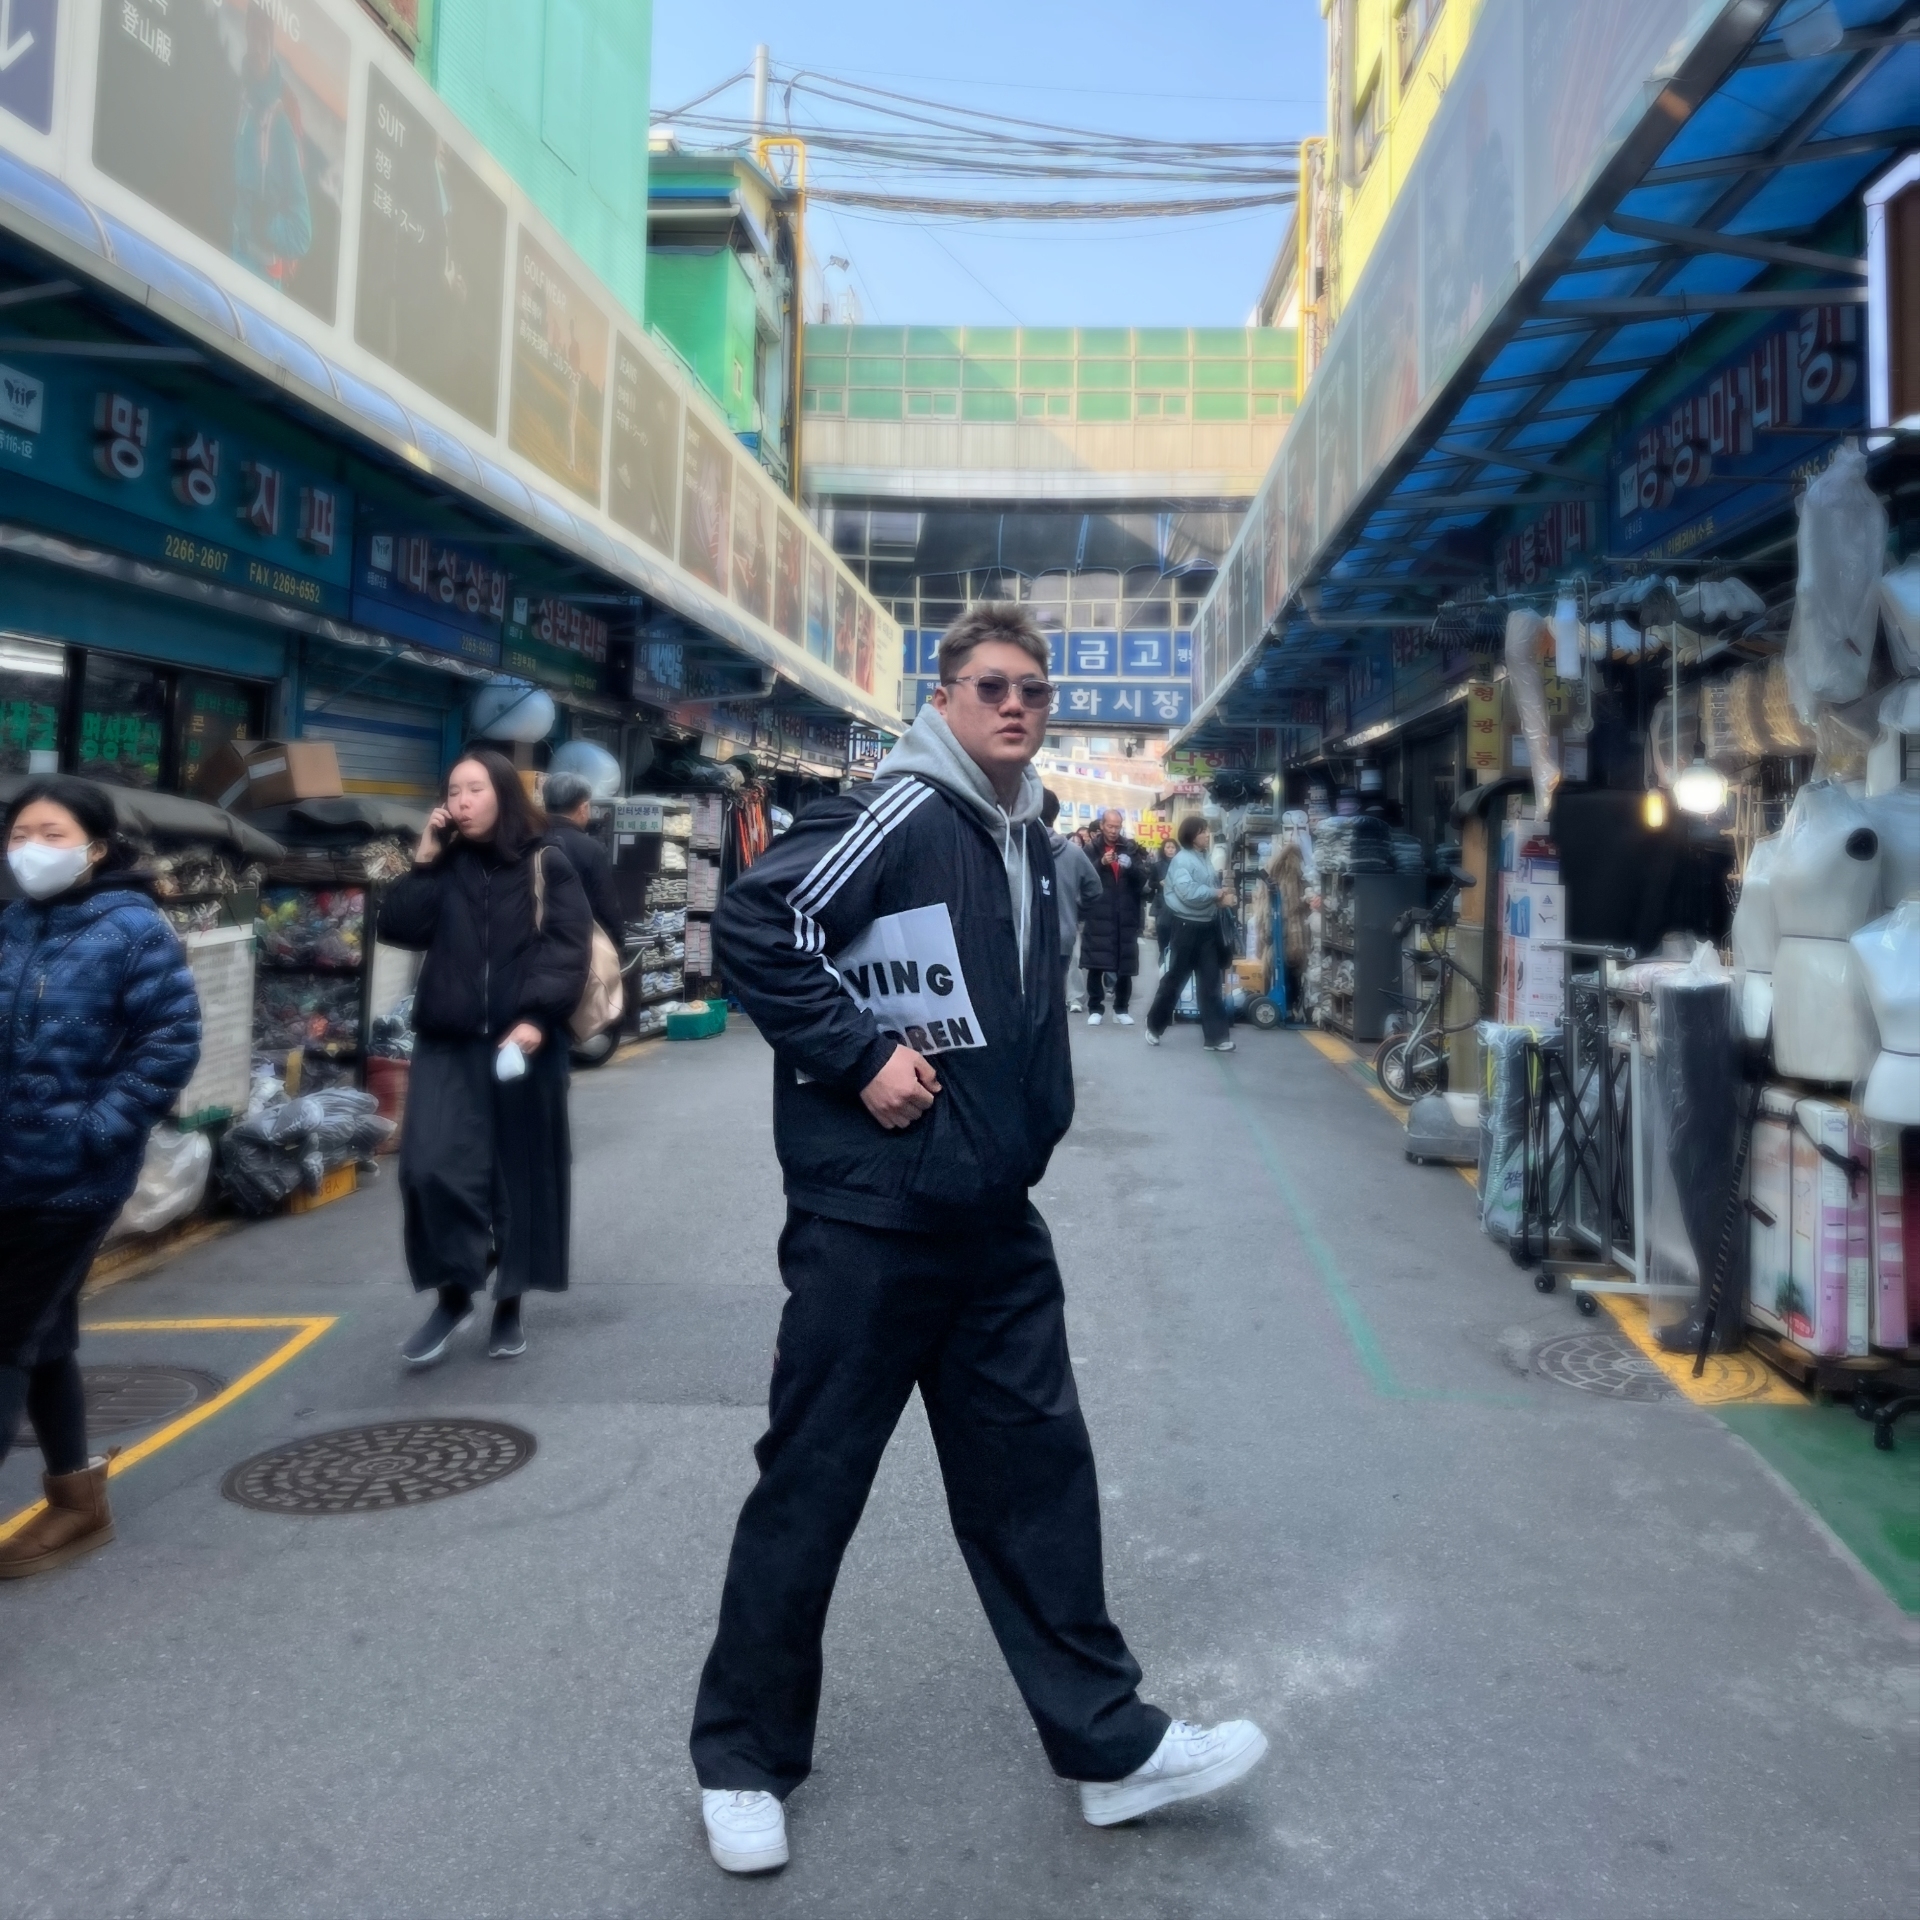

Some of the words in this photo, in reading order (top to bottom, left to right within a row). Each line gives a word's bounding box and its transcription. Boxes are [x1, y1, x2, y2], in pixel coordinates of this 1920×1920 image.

[121, 0, 172, 67] 登山服
[377, 102, 406, 148] SUIT
[375, 147, 392, 181] 정장
[523, 254, 545, 290] GOLF
[545, 275, 567, 314] WEAR
[618, 354, 638, 386] JEANS
[1636, 305, 1850, 511] 광명마네킹
[164, 534, 229, 574] 2266-2607
[249, 562, 269, 588] FAX
[272, 570, 321, 604] 2269-6552
[404, 537, 506, 623] 대성상회
[1470, 686, 1498, 767] 형광등
[616, 805, 660, 817] 인터넷봉투
[616, 820, 660, 831] 택배봉투
[1137, 823, 1173, 840] 다방
[842, 960, 955, 999] VING
